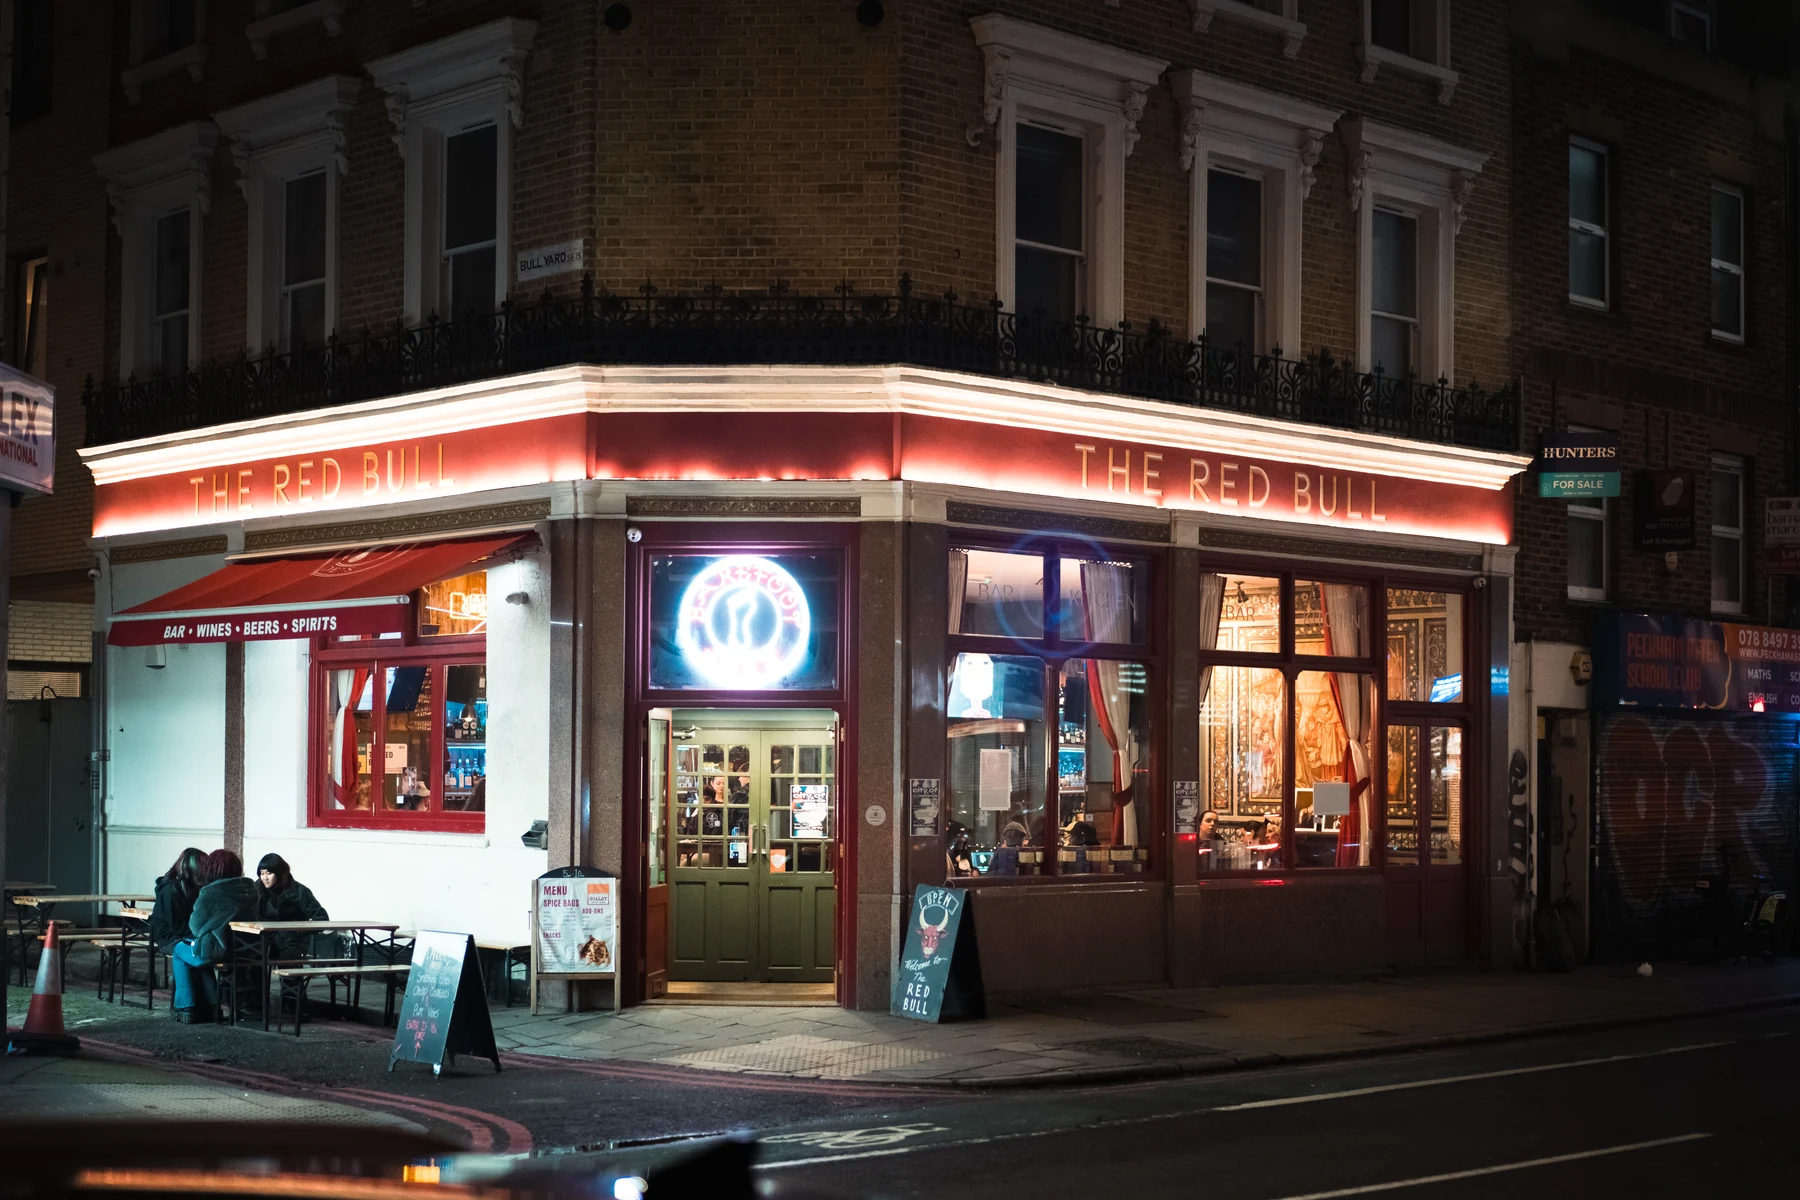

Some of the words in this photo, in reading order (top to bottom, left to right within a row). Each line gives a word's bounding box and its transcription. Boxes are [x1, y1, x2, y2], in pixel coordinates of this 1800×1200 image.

[520, 257, 542, 271] BULL
[544, 252, 566, 266] YARD
[1543, 447, 1616, 459] HUNTERS
[190, 469, 253, 516] THE
[273, 457, 341, 505] RED
[363, 442, 455, 496] BULL
[1074, 443, 1164, 496] THE
[1189, 457, 1270, 508] RED
[1294, 471, 1386, 521] BULL
[1553, 480, 1574, 489] FOR
[1577, 480, 1604, 489] SALE
[978, 583, 1014, 602] BAR
[1225, 604, 1255, 622] BAR
[163, 625, 186, 639] BAR
[196, 622, 232, 638] WINES
[243, 620, 280, 636] BEERS
[291, 616, 337, 633] SPIRITS
[1627, 632, 1684, 661] PECKHAM
[1739, 629, 1760, 647] 078
[1762, 631, 1789, 649] 8497
[1627, 663, 1671, 690] SCHOOL
[1673, 665, 1701, 692] CLUB
[1747, 668, 1772, 680] MATHS
[1748, 692, 1778, 704] ENGLISH
[913, 786, 928, 795] city
[543, 886, 567, 895] MENU
[926, 890, 952, 908] OPEN
[543, 899, 561, 908] SPICE
[563, 899, 580, 907] BAGS
[904, 959, 931, 971] Welcome
[933, 955, 948, 965] to
[914, 972, 927, 982] The
[906, 983, 930, 998] RED
[903, 997, 928, 1015] BULL
